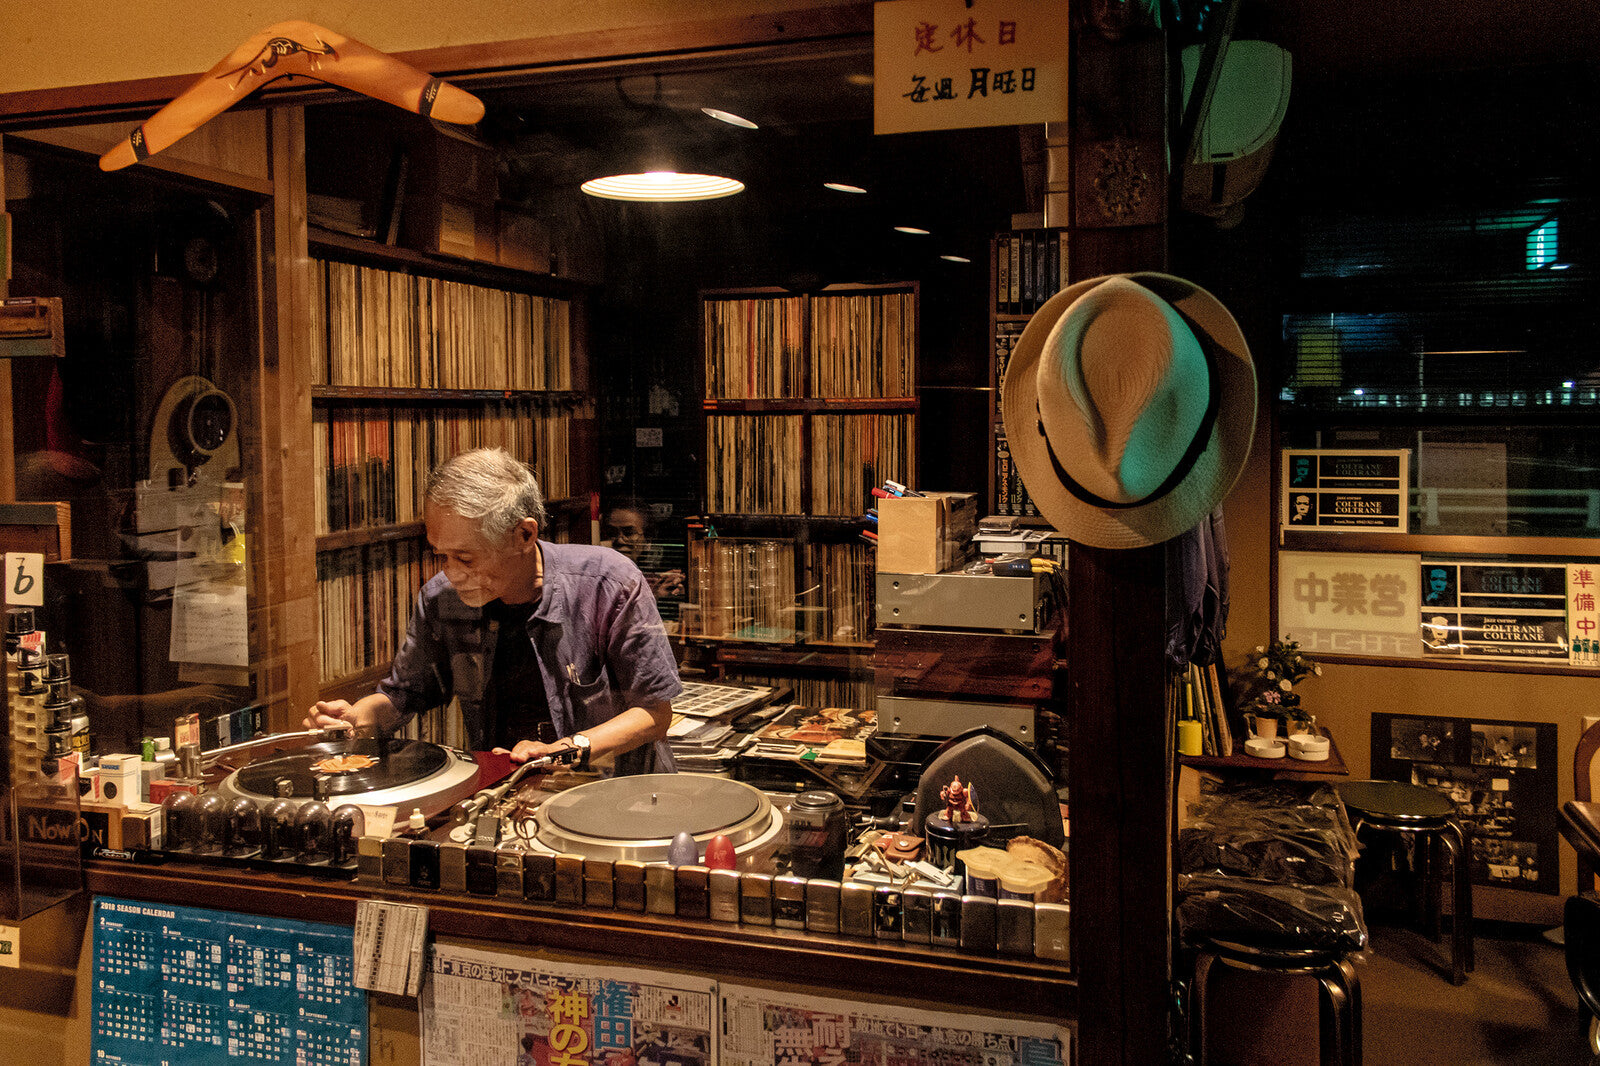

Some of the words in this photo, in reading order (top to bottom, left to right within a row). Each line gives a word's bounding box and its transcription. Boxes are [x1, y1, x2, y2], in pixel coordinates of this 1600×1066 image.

[914, 17, 1017, 57] 定休日
[1481, 575, 1541, 585] COLTRANE
[1481, 584, 1541, 593] COLTRANE
[1573, 568, 1596, 636] 準備中
[1482, 624, 1544, 634] COLTRANE
[1483, 632, 1545, 641] COLTRANE
[101, 902, 116, 911] 2018
[116, 903, 142, 914] SEASON
[142, 906, 176, 919] CALENDAR
[100, 917, 105, 925] 2
[163, 926, 168, 934] 3
[229, 934, 234, 942] 4
[298, 943, 304, 951] 5
[99, 980, 104, 988] 6
[163, 989, 168, 998] 7
[229, 999, 234, 1007] 8
[299, 1007, 305, 1016] 9
[592, 978, 633, 1049] 権田
[548, 990, 590, 1066] 神の
[774, 1025, 813, 1066] 無
[97, 1049, 105, 1058] 10
